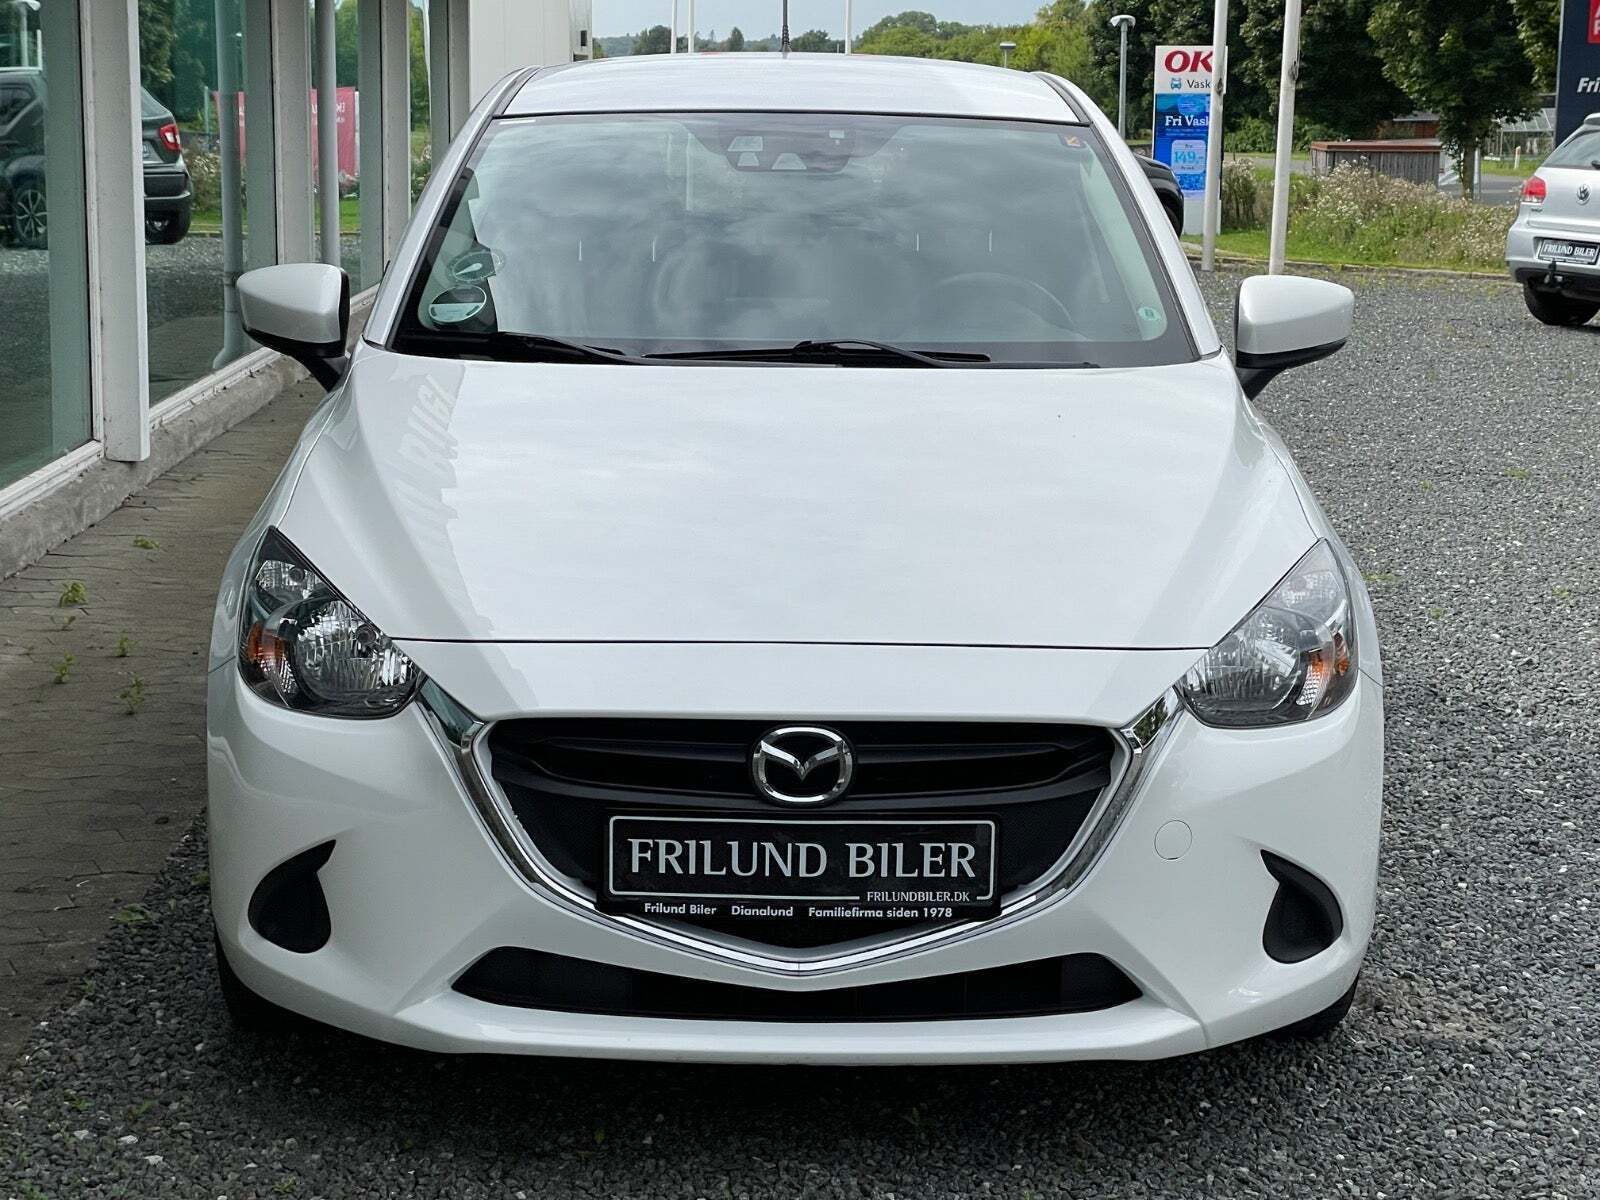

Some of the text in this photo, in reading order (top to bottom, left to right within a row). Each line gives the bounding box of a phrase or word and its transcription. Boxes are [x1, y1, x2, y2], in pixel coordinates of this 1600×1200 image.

[1164, 50, 1213, 73] OK
[1187, 79, 1211, 89] Vask
[1576, 76, 1600, 94] Fri
[1165, 115, 1182, 126] Fri
[1544, 243, 1596, 257] FRILUND BILER
[627, 838, 976, 878] FRILUND BILER
[867, 891, 970, 902] FRILUNDBILER.DK
[644, 902, 953, 918] Frilund Biler Dianalund Familiefirma siden 1978
